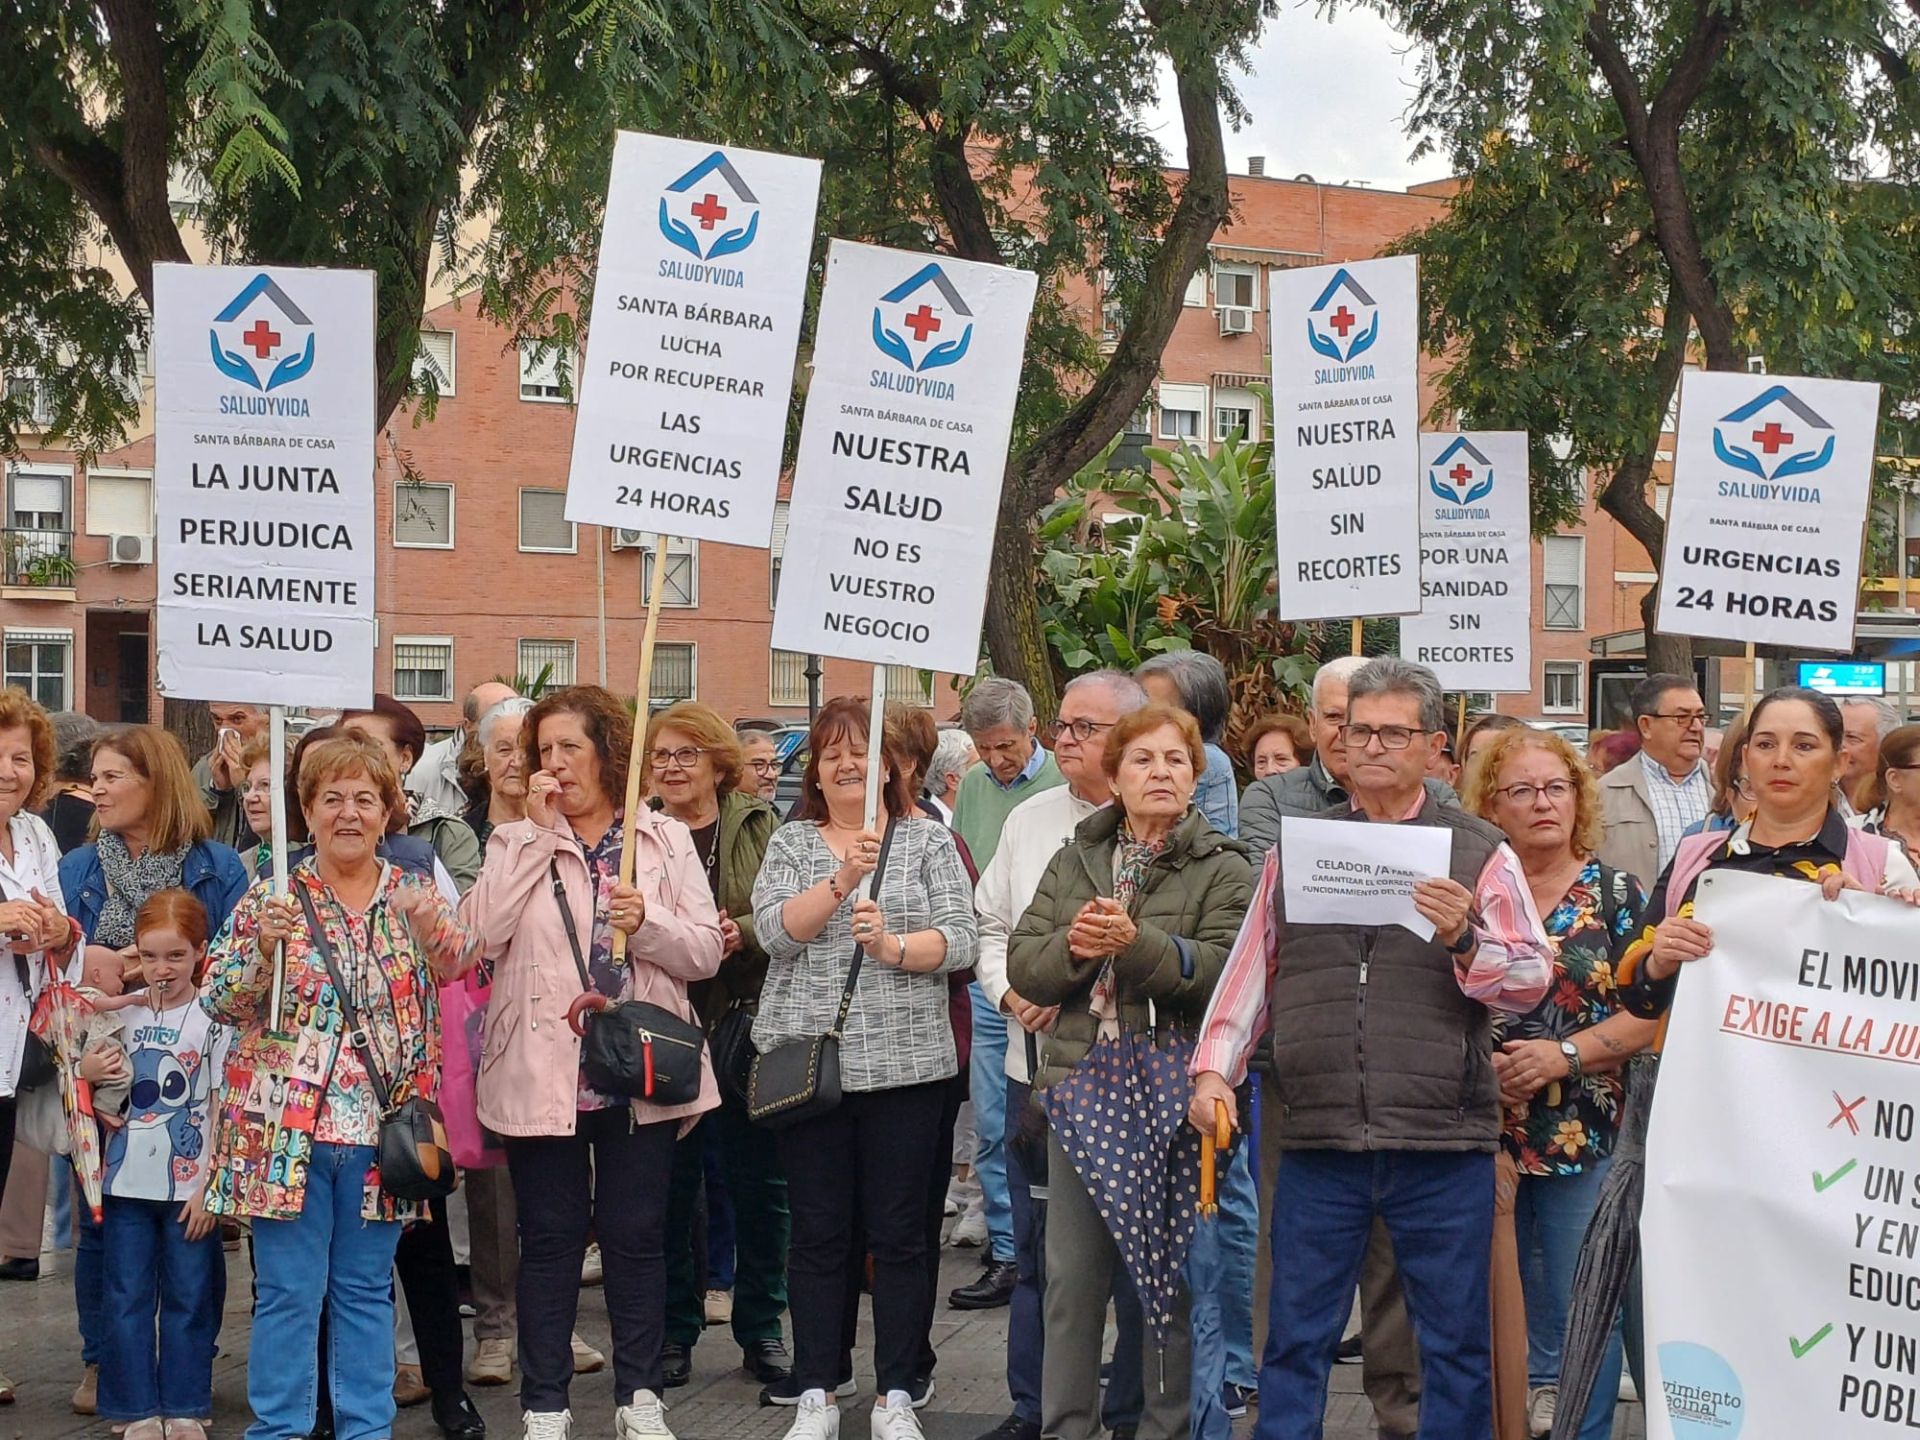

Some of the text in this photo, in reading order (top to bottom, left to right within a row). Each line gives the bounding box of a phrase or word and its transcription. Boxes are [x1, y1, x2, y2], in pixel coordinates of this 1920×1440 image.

[658, 259, 745, 289] SALUDYVIDA
[617, 294, 774, 332] SANTA BÁRBARA
[660, 334, 722, 358] LUCHA
[609, 360, 765, 398] POR RECUPERAR
[869, 369, 955, 401] SALUDYVIDA
[1314, 364, 1375, 385] SALUDYVIDA
[219, 395, 310, 418] SALUDYVIDA
[1298, 394, 1393, 412] SANTA BÁRBARA DE CASA
[660, 411, 702, 435] LAS
[840, 404, 973, 434] SANTA BÁRBARA DE CASA
[1297, 417, 1396, 447] NUESTRA
[193, 434, 336, 450] SANTA BÁRBARA DE CASA
[831, 430, 971, 476] NUESTRA
[609, 443, 742, 480] URGENCIAS
[1311, 463, 1382, 490] SALUD
[191, 462, 340, 494] LA JUNTA
[1718, 481, 1821, 504] SALUDYVIDA
[615, 485, 731, 519] 24 HORAS
[843, 484, 943, 523] SALUD
[1435, 508, 1491, 520] SALUDYVIDA
[180, 518, 354, 551] PERJUDICA
[1330, 511, 1365, 536] SIN
[1709, 517, 1739, 527] SANTA
[1781, 524, 1794, 532] DE
[1796, 525, 1821, 534] CASA
[853, 536, 921, 564] NO ES
[1421, 547, 1509, 565] POR UNA
[1683, 545, 1841, 578] URGENCIAS
[1298, 552, 1401, 583] RECORTES
[173, 572, 358, 606] SERIAMENTE
[829, 572, 935, 605] VUESTRO
[1421, 580, 1509, 597] SANIDAD
[1675, 587, 1838, 622] 24 HORAS
[197, 622, 333, 653] LA SALUD
[823, 611, 930, 644] NEGOCIO
[1449, 614, 1480, 630] SIN
[1418, 646, 1514, 663] RECORTES
[1311, 874, 1364, 886] GARANTIZAR
[1316, 859, 1371, 874] CELADOR
[1302, 885, 1379, 897] FUNCIONAMIENTO
[1380, 888, 1396, 896] DEL
[1798, 948, 1832, 991] EL
[1723, 994, 1809, 1042] EXIGE
[1811, 1011, 1831, 1046] A
[1838, 1015, 1874, 1052] LA
[1874, 1099, 1915, 1143] NO
[1864, 1165, 1904, 1205] UN
[1855, 1213, 1919, 1259] Y EN
[1849, 1262, 1920, 1311] EDUC
[1846, 1322, 1916, 1376] Y UN
[1839, 1373, 1920, 1429] POBL
